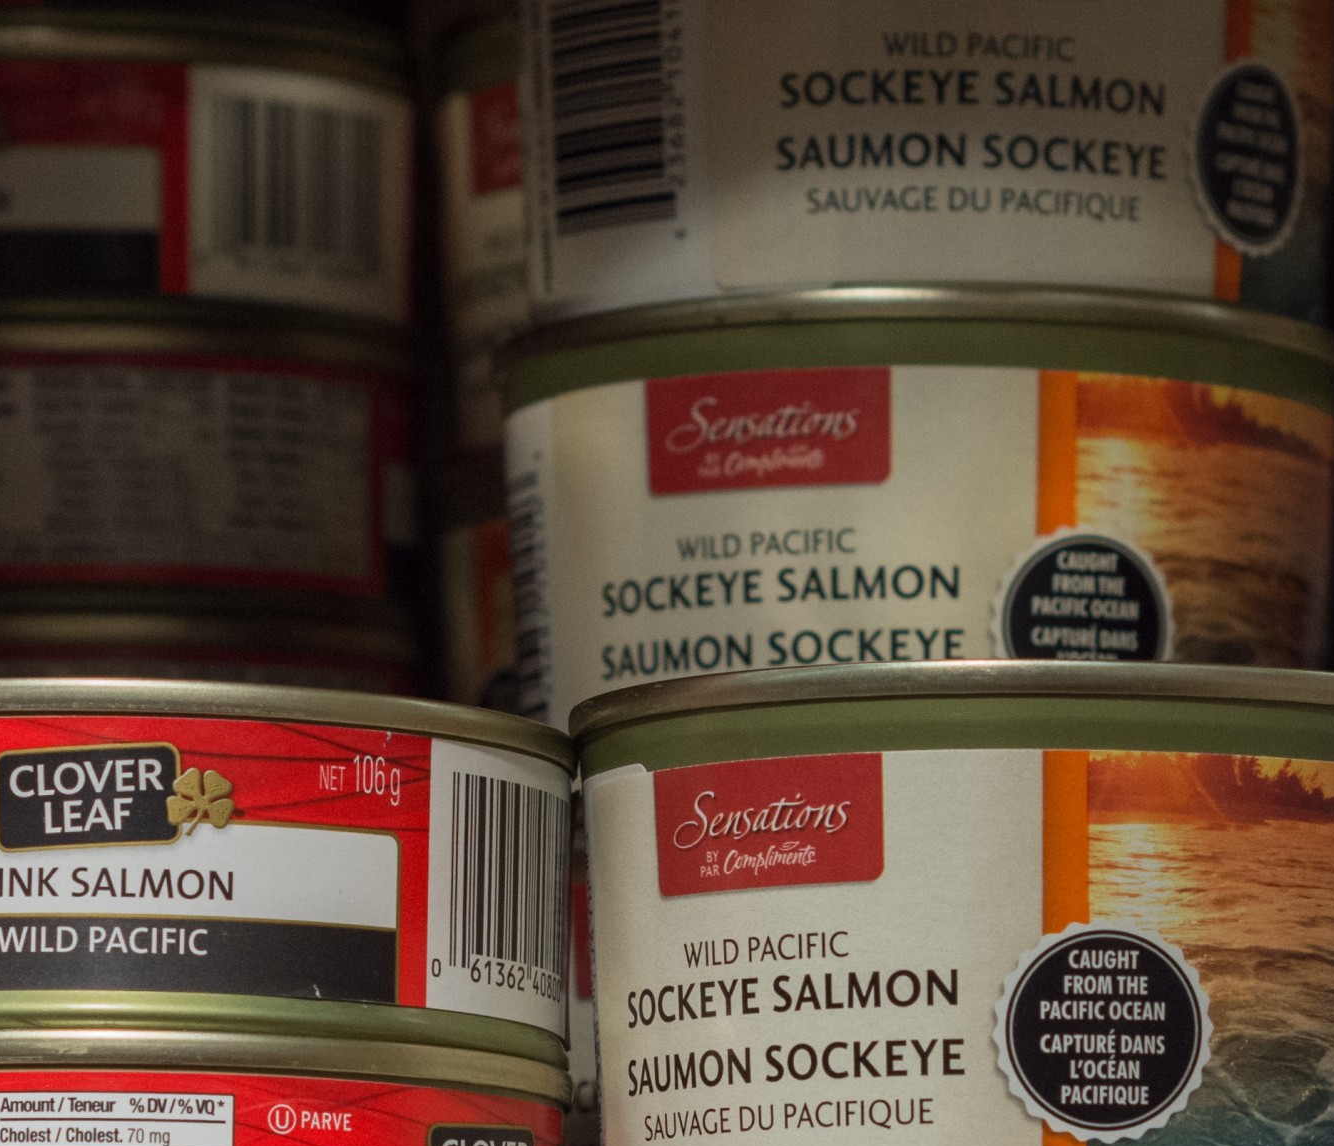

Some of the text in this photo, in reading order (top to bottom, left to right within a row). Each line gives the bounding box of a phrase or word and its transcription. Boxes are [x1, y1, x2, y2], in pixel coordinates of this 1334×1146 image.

[779, 69, 1165, 116] SOCKEYE SALMON
[776, 134, 1165, 180] SAUMON SOCKEYE
[806, 186, 1140, 222] SAUVAGE DU PACIFIQUE
[602, 565, 960, 618] SOCKEYE SALMON
[10, 759, 163, 797] CLOVER
[320, 765, 345, 791] NET
[354, 755, 385, 795] 106
[44, 797, 133, 834] LEAF
[674, 790, 851, 849] Sensations
[724, 842, 816, 875] Compliments
[71, 869, 233, 900] SALMON
[684, 931, 849, 968] WILD PACIFIC
[1068, 950, 1139, 970] CAUGHT
[628, 969, 958, 1029] SOCKEYE SALMON
[1063, 975, 1148, 995] FROM THE
[1039, 1001, 1166, 1021] PACIFIC OCEAN
[629, 1038, 965, 1097] SAUMON SOCKEYE
[0, 1127, 144, 1143] Cholest Cholest. 70
[301, 1111, 352, 1131] PARVE
